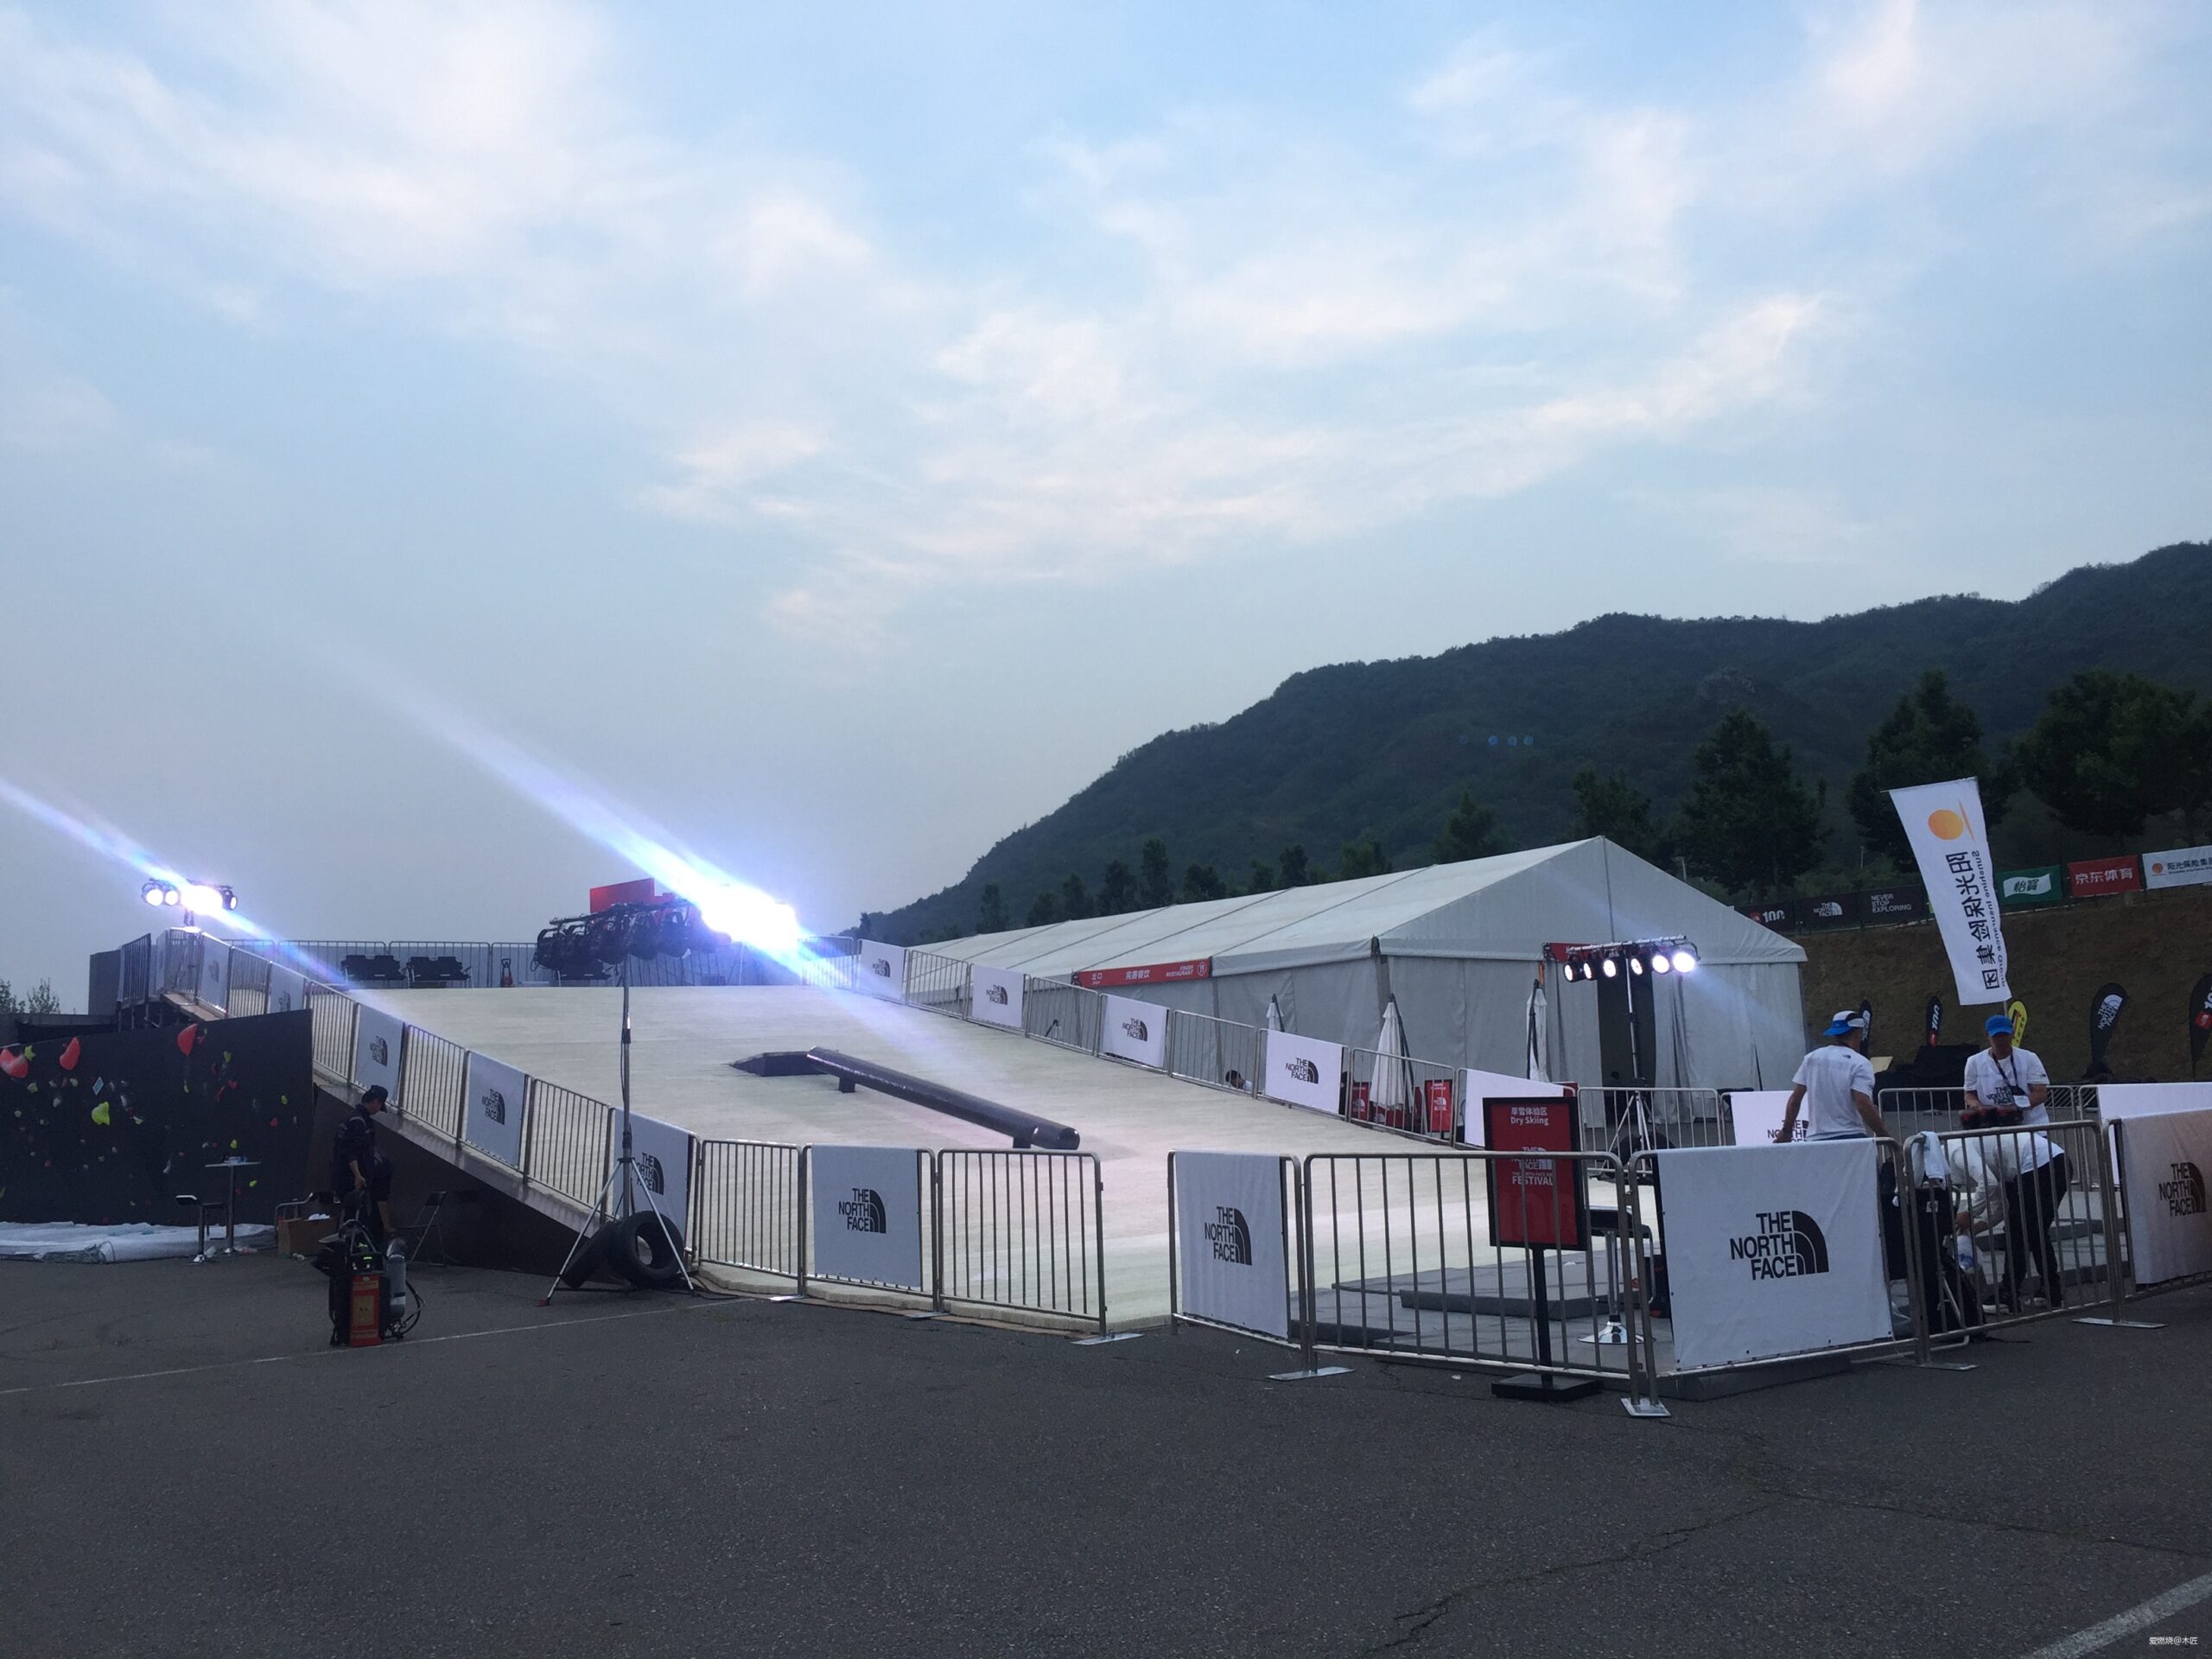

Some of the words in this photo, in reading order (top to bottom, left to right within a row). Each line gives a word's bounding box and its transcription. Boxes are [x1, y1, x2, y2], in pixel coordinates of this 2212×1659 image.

[2075, 868, 2133, 885] 京东体育
[1763, 910, 1785, 923] 100
[1872, 904, 1912, 913] EXPLORING
[1286, 1063, 1307, 1075] NORTH
[1296, 1058, 1307, 1067] THE
[1291, 1071, 1306, 1082] FACE
[1510, 1116, 1523, 1126] Dry
[1525, 1116, 1549, 1126] Skiing
[641, 1152, 654, 1167] THE
[2171, 1162, 2190, 1180] THE
[1512, 1176, 1554, 1185] FESTIVAL
[852, 1188, 869, 1203] THE
[2158, 1179, 2190, 1201] NORTH
[838, 1201, 869, 1217] NORTH
[1216, 1206, 1233, 1225] THE
[2170, 1198, 2192, 1217] FACE
[847, 1217, 869, 1232] FACE
[1756, 1211, 1792, 1234] THE
[1204, 1222, 1235, 1244] NORTH
[1213, 1242, 1236, 1263] FACE
[1729, 1233, 1794, 1260] NORTH
[1751, 1255, 1796, 1281] FACE
